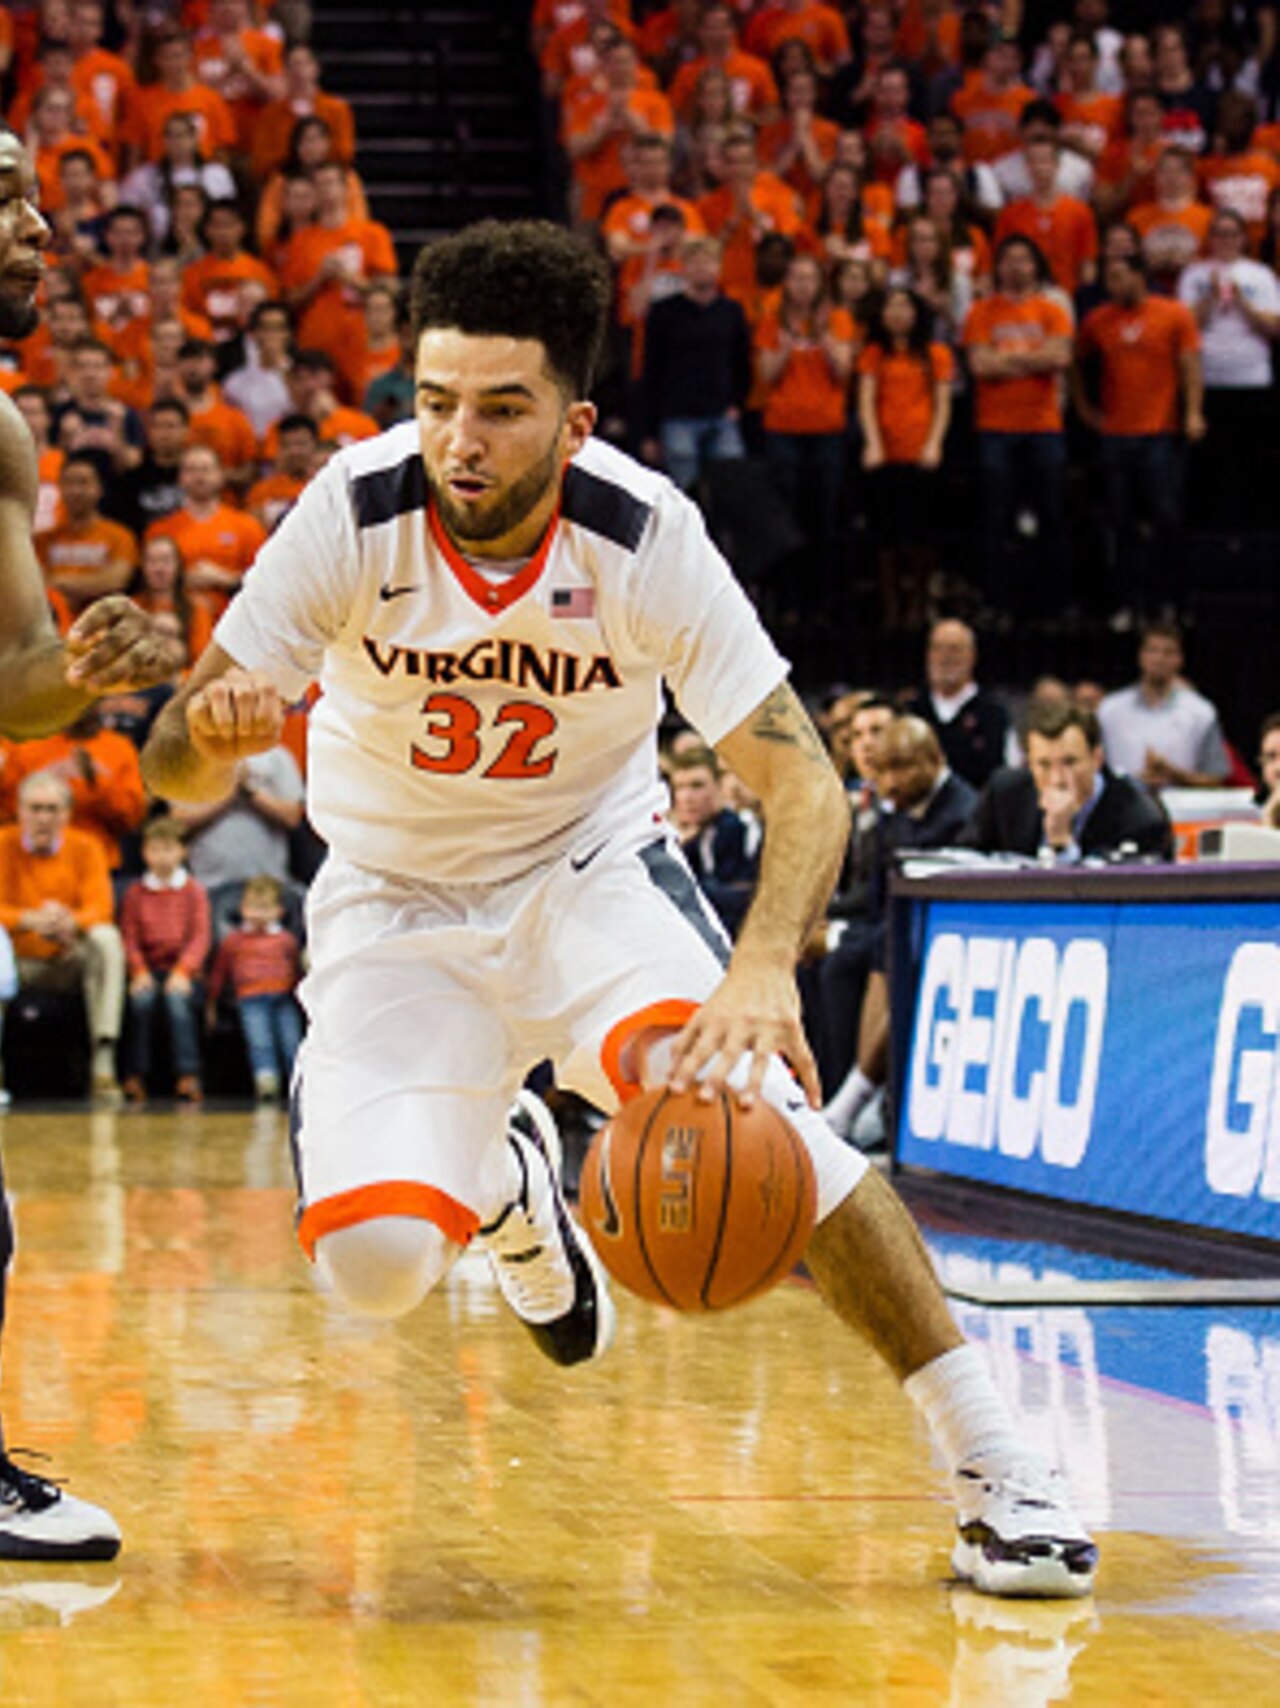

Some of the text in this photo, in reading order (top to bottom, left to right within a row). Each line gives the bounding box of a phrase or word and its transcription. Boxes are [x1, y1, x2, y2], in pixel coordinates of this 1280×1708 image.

[362, 635, 624, 696] VIRGINIA
[410, 692, 559, 779] 32
[909, 932, 1108, 1168] GEICO
